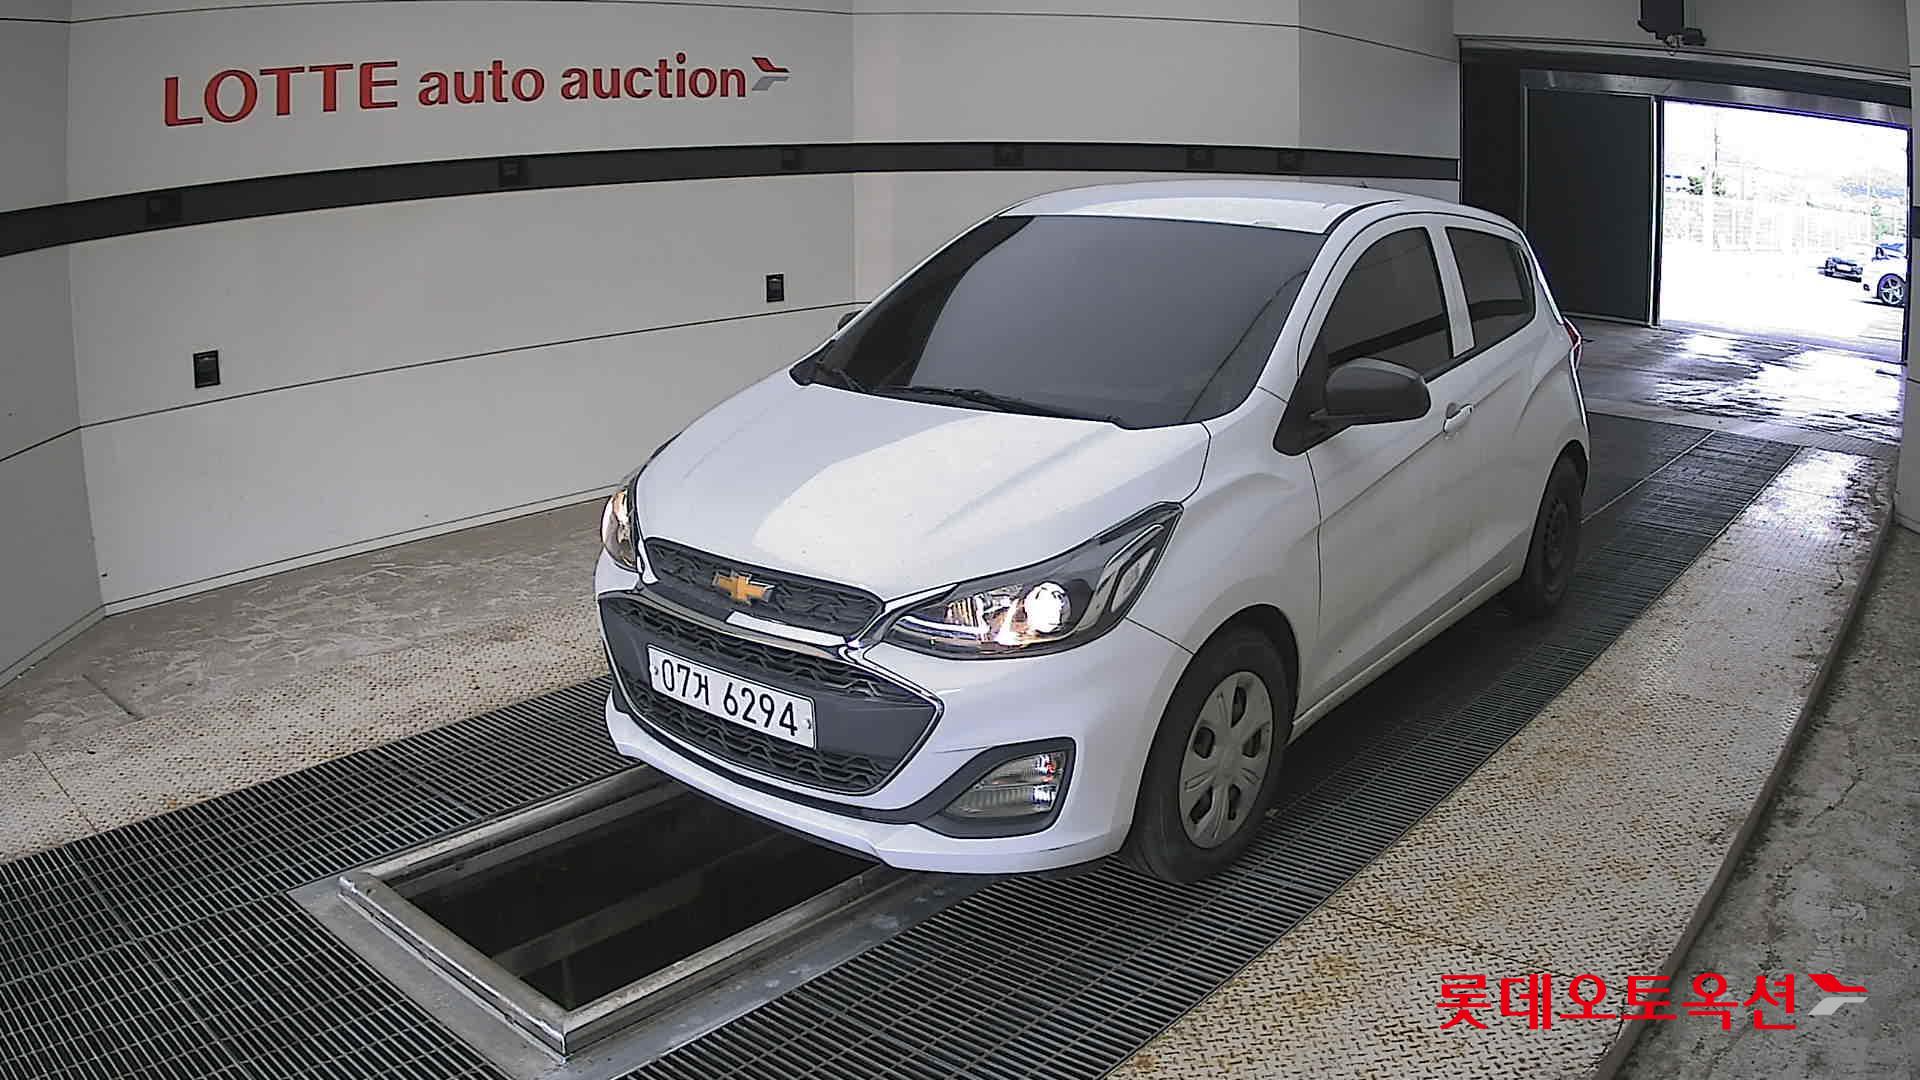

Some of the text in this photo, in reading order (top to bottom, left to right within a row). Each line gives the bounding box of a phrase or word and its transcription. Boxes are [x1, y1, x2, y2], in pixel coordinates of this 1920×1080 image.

[164, 52, 748, 127] LOTTE auto auction
[661, 659, 798, 736] 07거 6294
